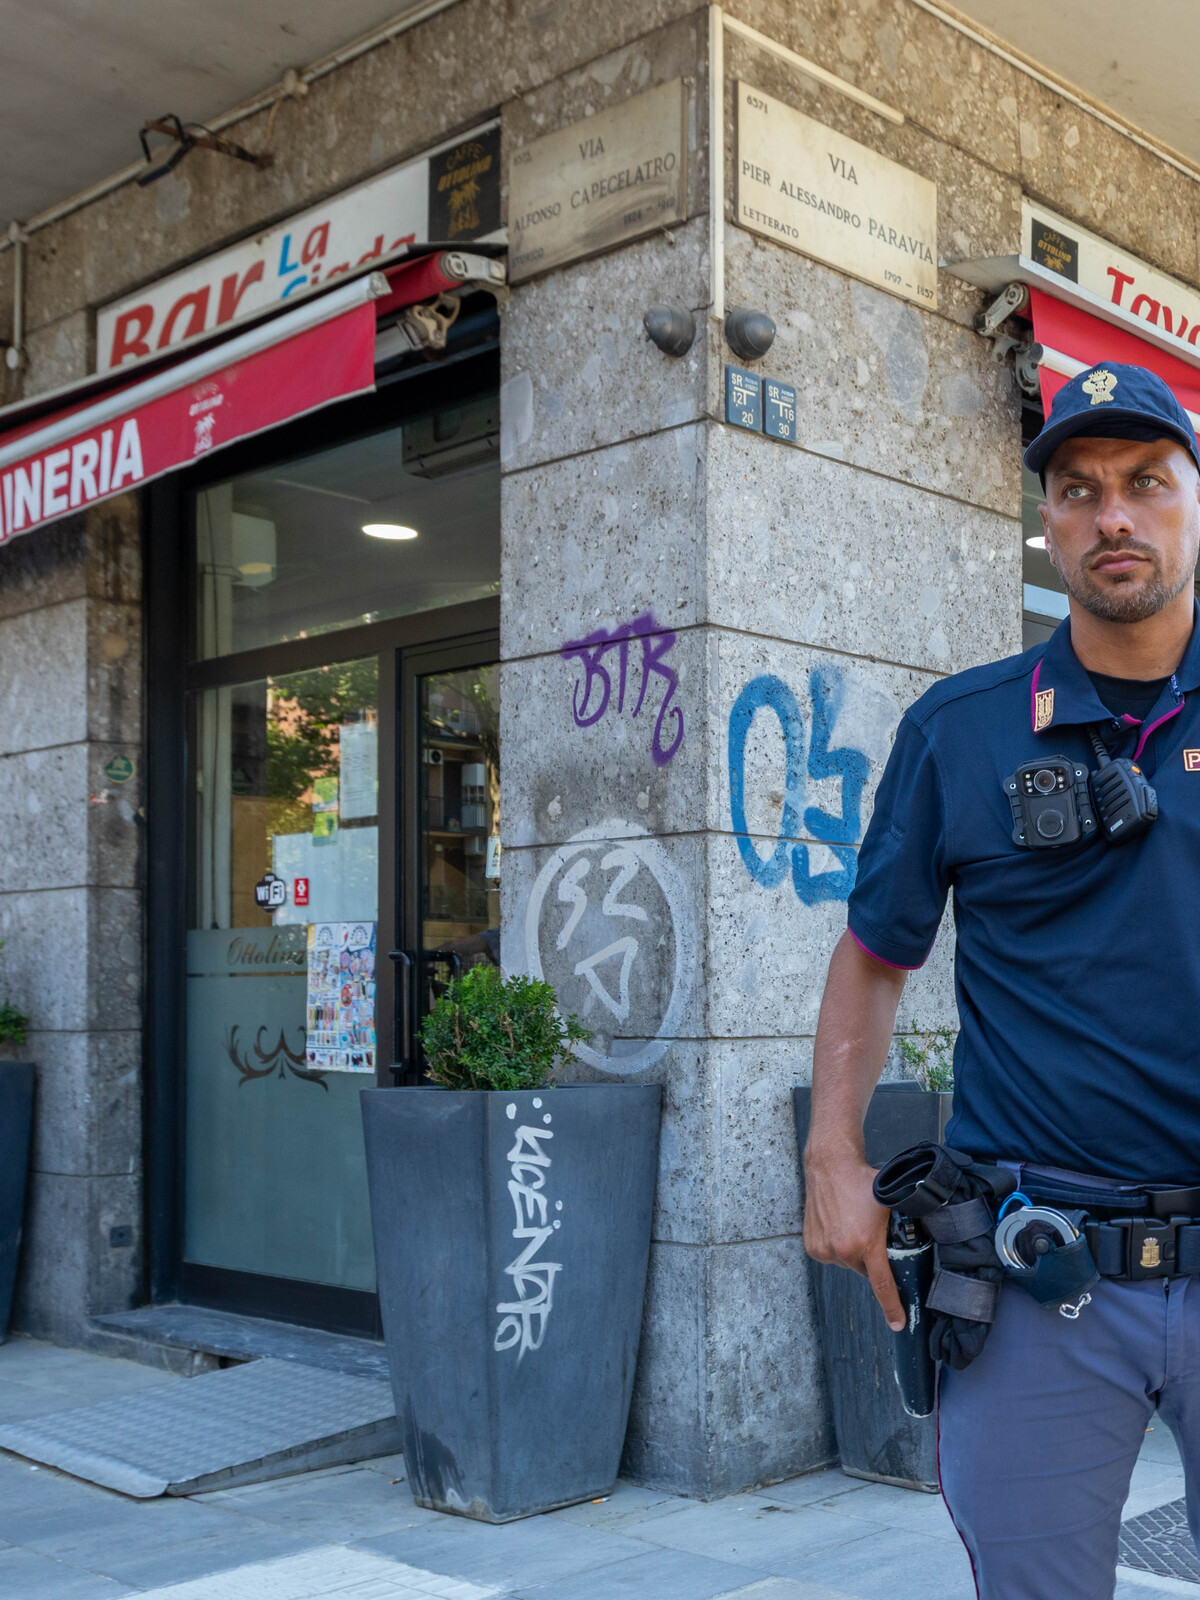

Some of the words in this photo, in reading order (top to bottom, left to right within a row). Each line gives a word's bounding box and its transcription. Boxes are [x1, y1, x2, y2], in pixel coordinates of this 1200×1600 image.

[578, 135, 605, 160] VIA
[828, 152, 859, 185] VIA
[513, 201, 562, 233] ALFONSO
[570, 151, 677, 209] CAPECELATRO
[742, 160, 771, 186] PIER
[779, 179, 861, 228] ALESSANDRO
[868, 217, 934, 264] PARAVIA
[742, 204, 800, 239] LETTERATO
[278, 220, 331, 277] La
[883, 269, 903, 285] 1797
[916, 284, 935, 300] 1857
[109, 260, 265, 369] Bar
[731, 373, 743, 387] SR
[768, 385, 780, 400] SR
[0, 417, 144, 541] INERIA
